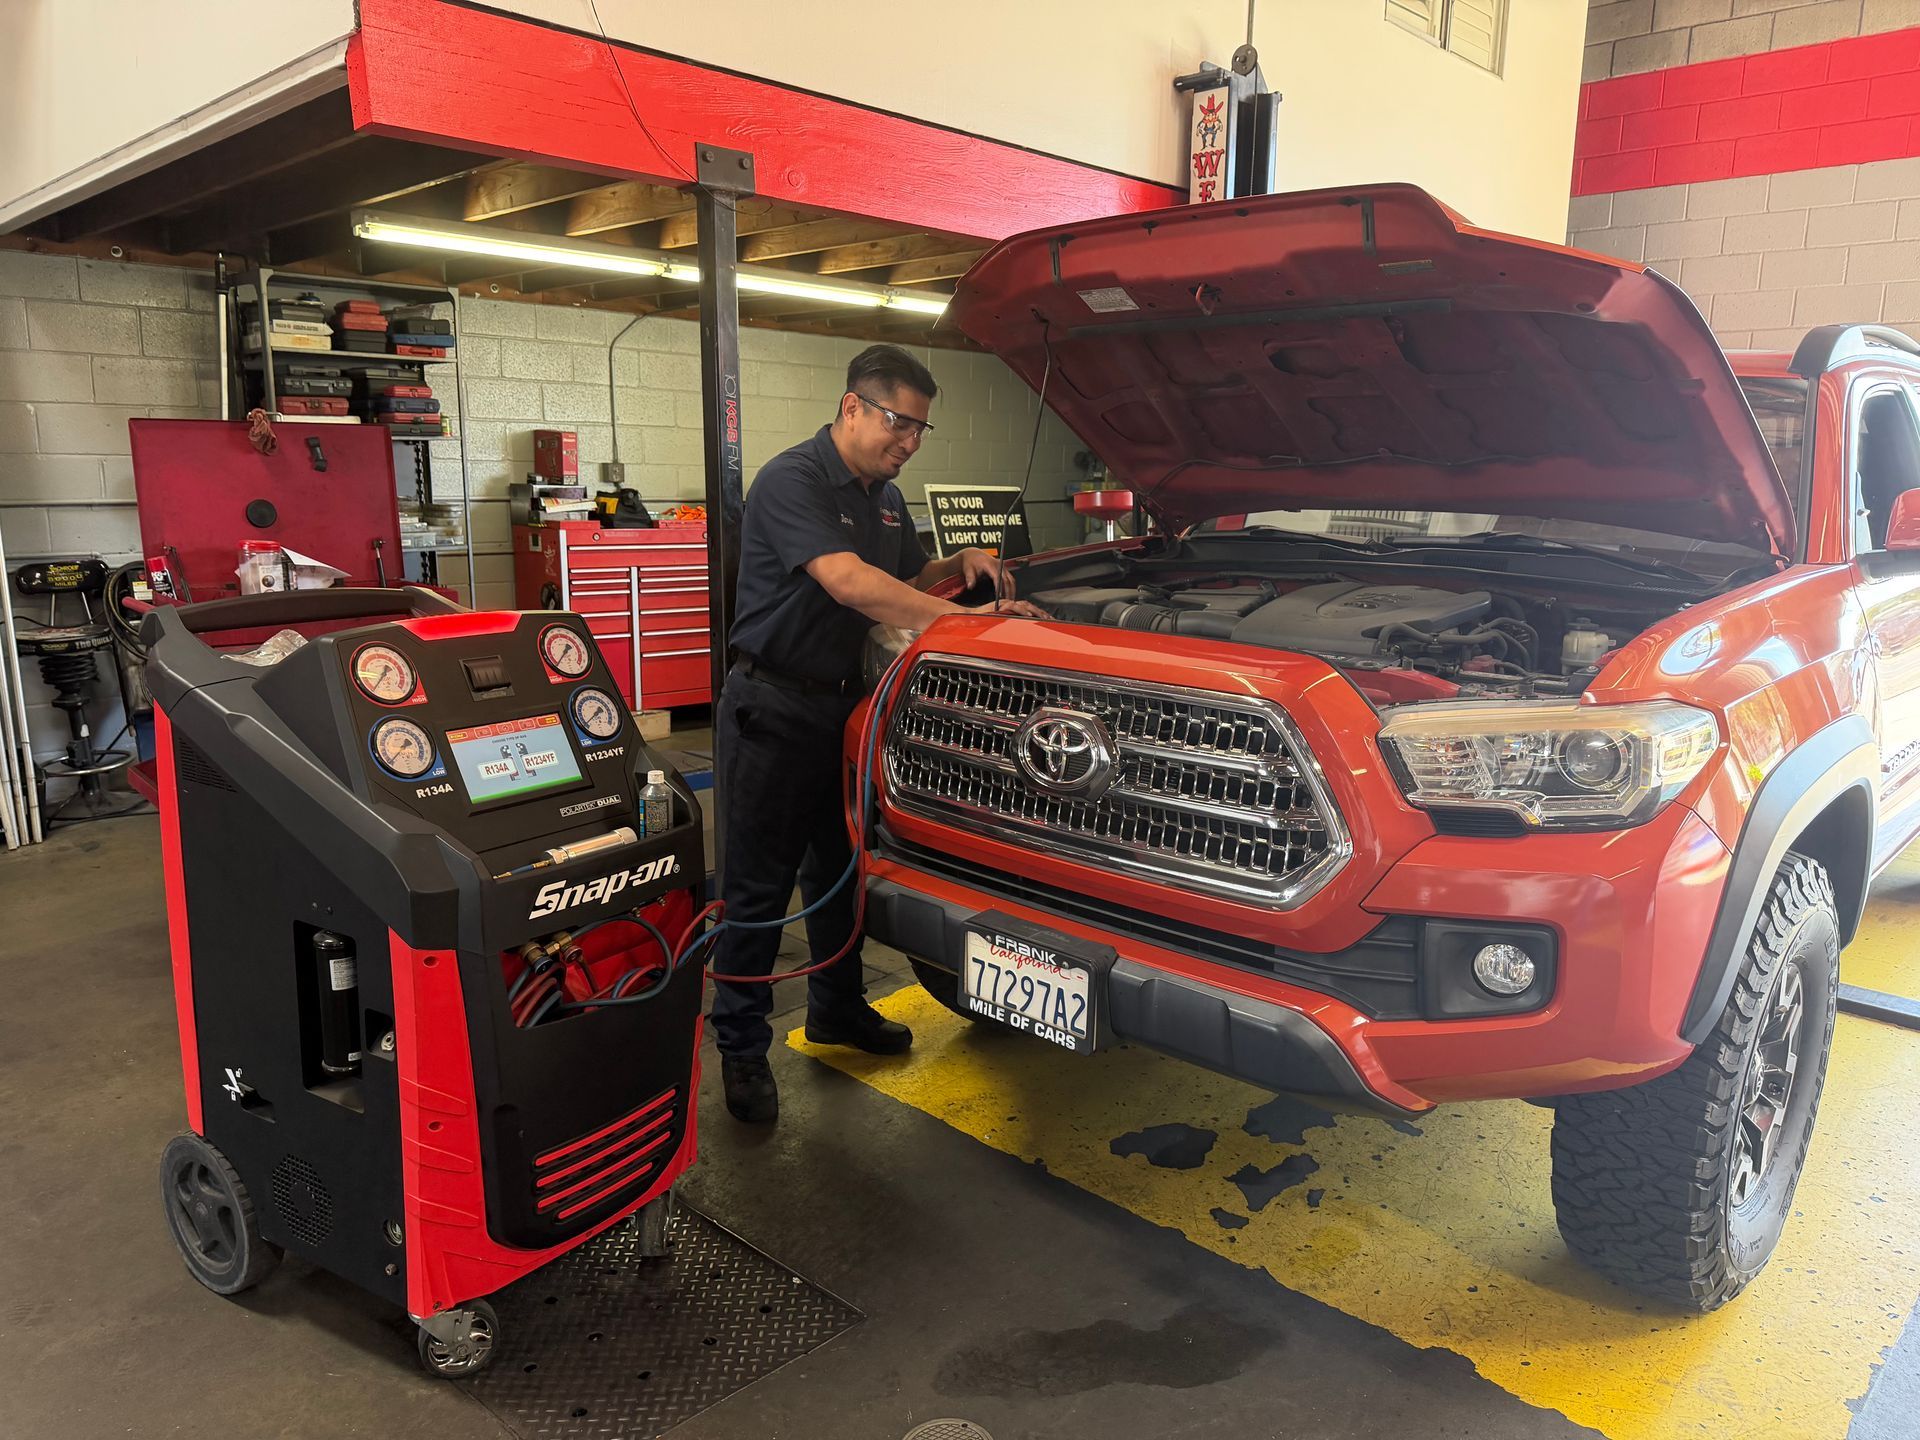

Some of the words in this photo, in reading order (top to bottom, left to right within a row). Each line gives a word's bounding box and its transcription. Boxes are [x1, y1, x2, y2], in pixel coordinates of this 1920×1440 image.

[726, 400, 738, 443] KGB
[727, 444, 740, 470] FM
[936, 497, 950, 509] IS
[951, 497, 984, 509] YOUR
[941, 514, 980, 527] CHECK
[944, 532, 978, 545] LIGHT
[980, 531, 1002, 544] ON?
[585, 746, 625, 762] R1234YF
[484, 763, 510, 776] R134A
[524, 753, 555, 767] R1234YF
[416, 783, 454, 799] R134A
[597, 796, 619, 807] DUAL
[995, 934, 1057, 965] FRANK
[971, 956, 1086, 1036] 77297A2
[969, 996, 1006, 1022] MILE
[1009, 1012, 1030, 1030] OF
[1034, 1021, 1076, 1050] CARS
